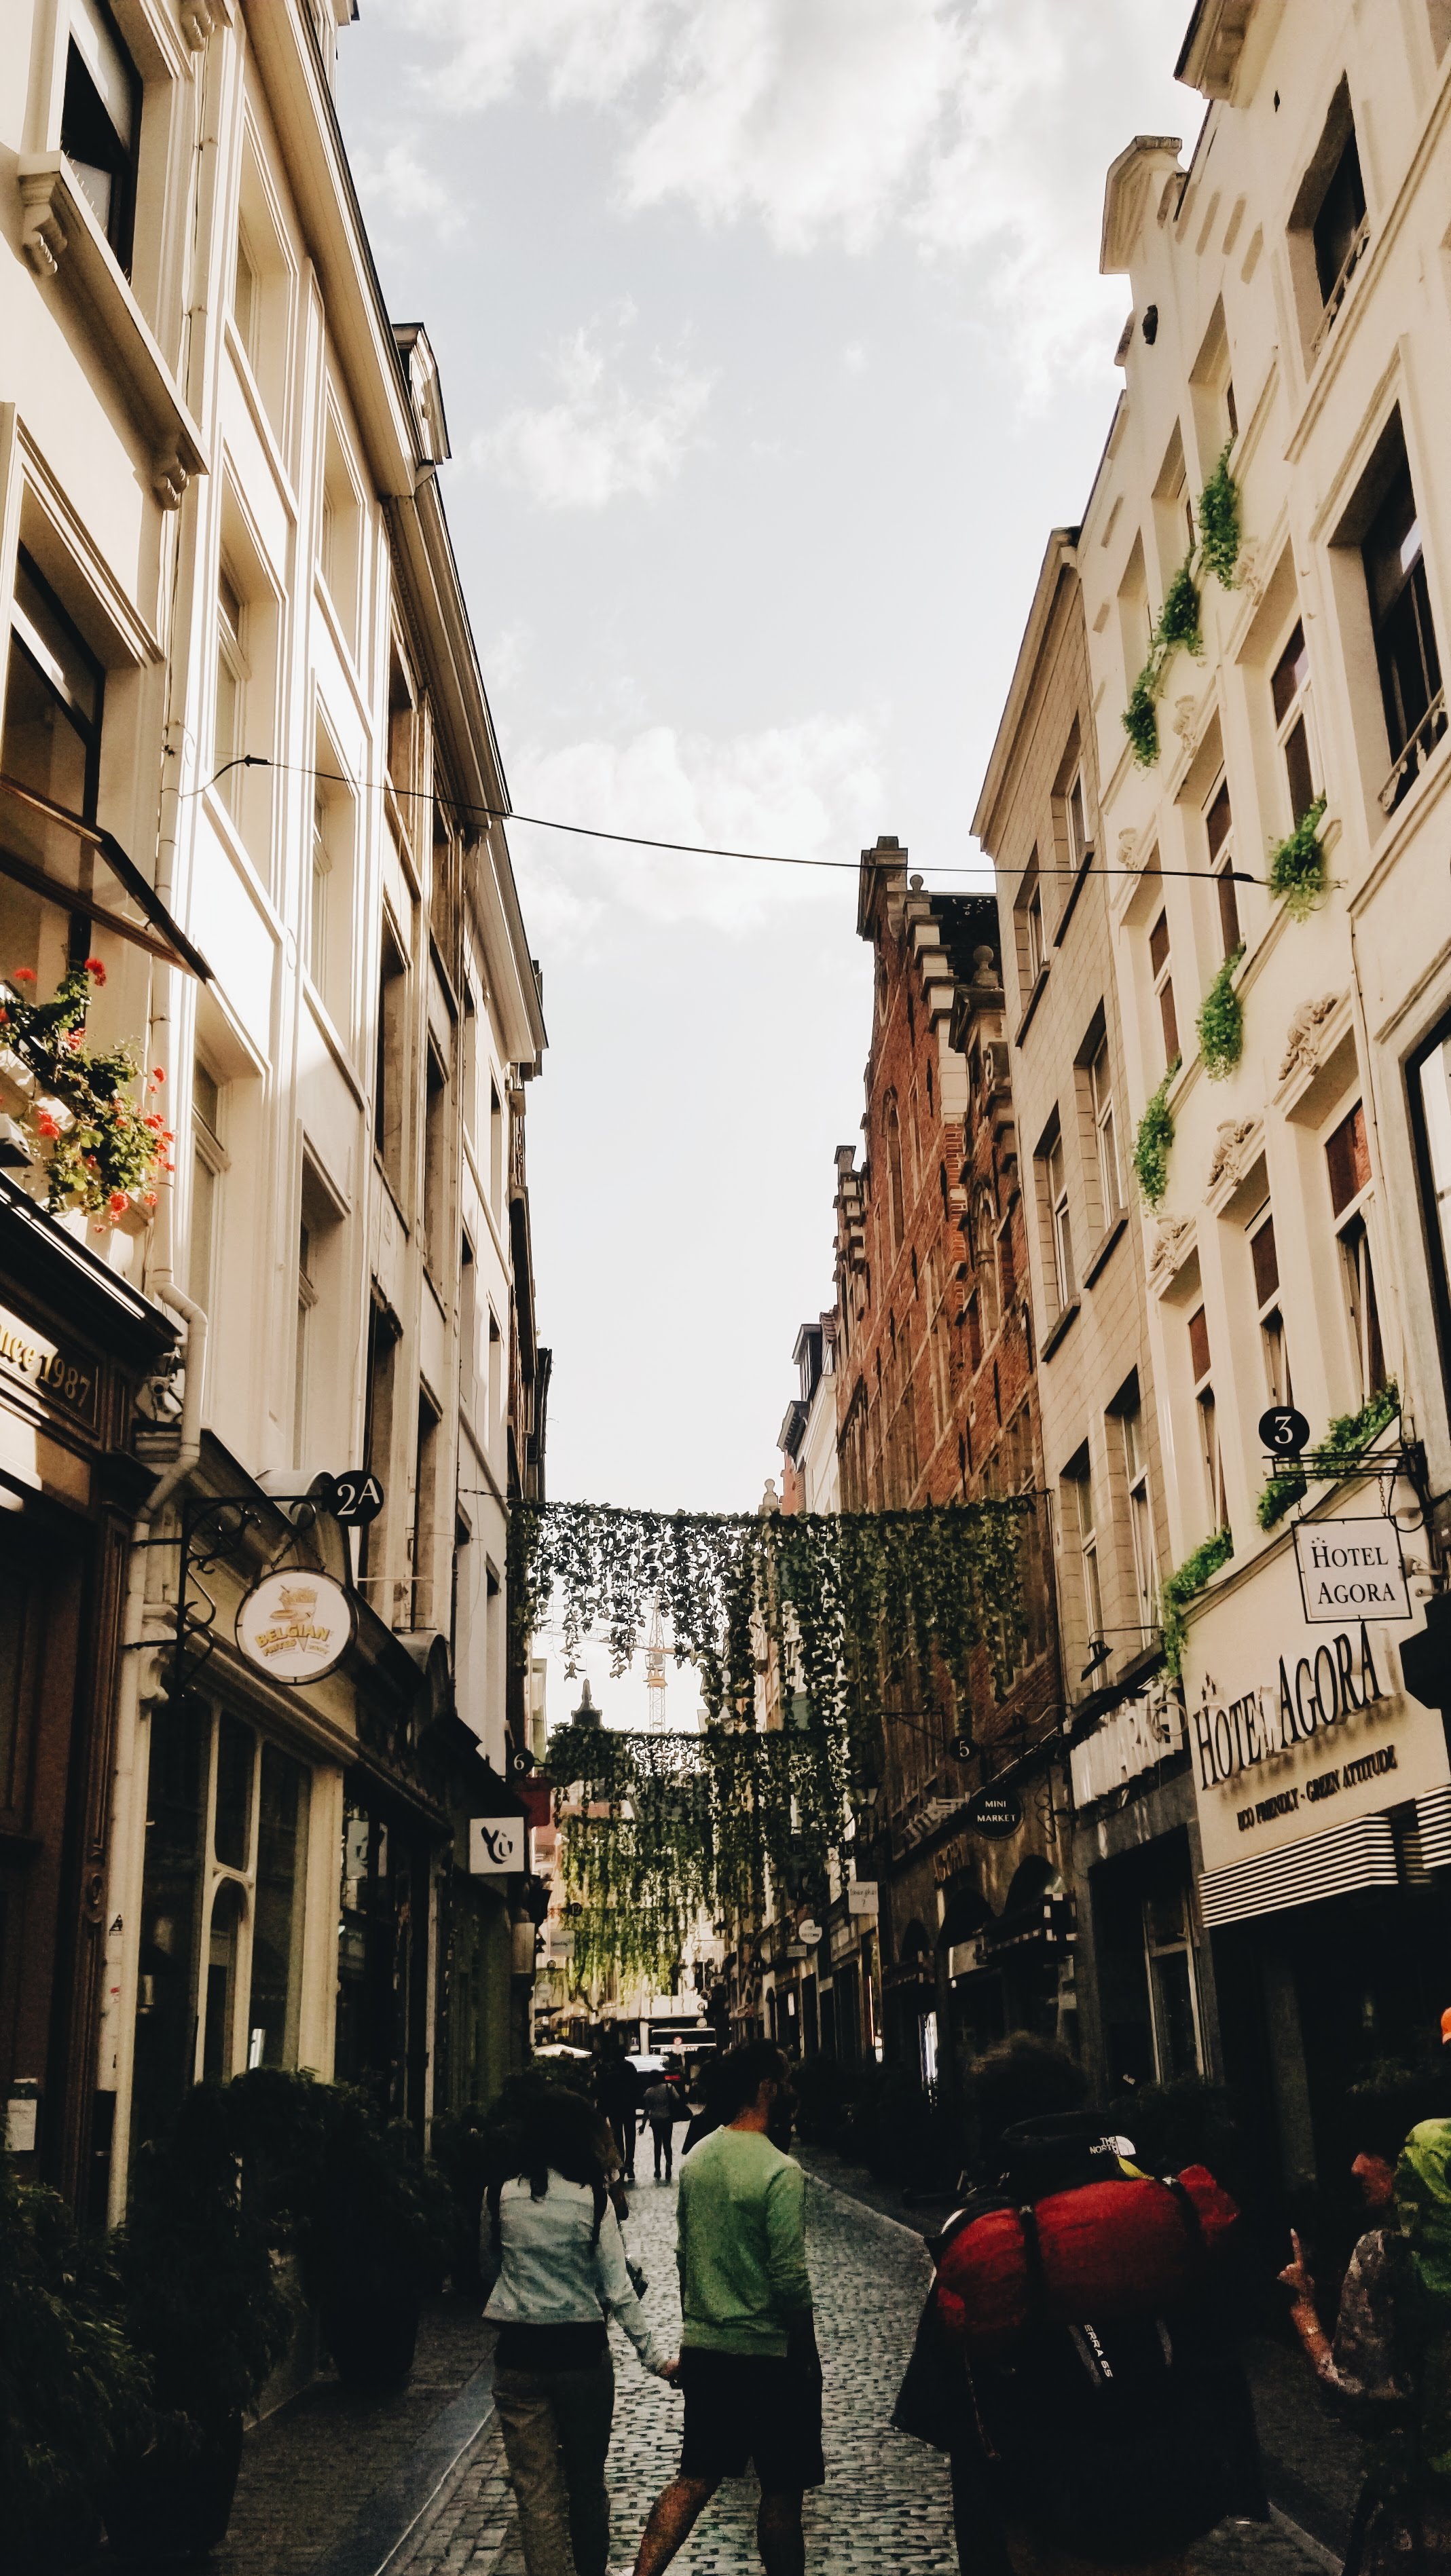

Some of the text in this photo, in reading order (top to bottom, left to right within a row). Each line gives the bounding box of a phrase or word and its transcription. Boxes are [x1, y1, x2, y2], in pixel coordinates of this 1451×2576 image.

[0, 1322, 91, 1407] nce 1987
[1274, 1415, 1293, 1444] 3
[337, 1478, 380, 1516] 2A
[1310, 1545, 1389, 1569] HOTEL
[1317, 1582, 1397, 1605] AGORA
[255, 1624, 331, 1649] BELGIAN
[1192, 1684, 1274, 1791] HOTEL
[1278, 1620, 1384, 1750] AGORA
[959, 1740, 970, 1757] 5
[513, 1753, 526, 1770] 6
[1236, 1807, 1255, 1832] ECO
[1254, 1787, 1300, 1825] FRIENDLY
[1306, 1768, 1342, 1803] GREEN
[1342, 1744, 1398, 1789] ATTITUDE
[976, 1814, 1016, 1823] MARKET
[1099, 2136, 1116, 2146] THE
[1084, 2324, 1104, 2357] ERRA
